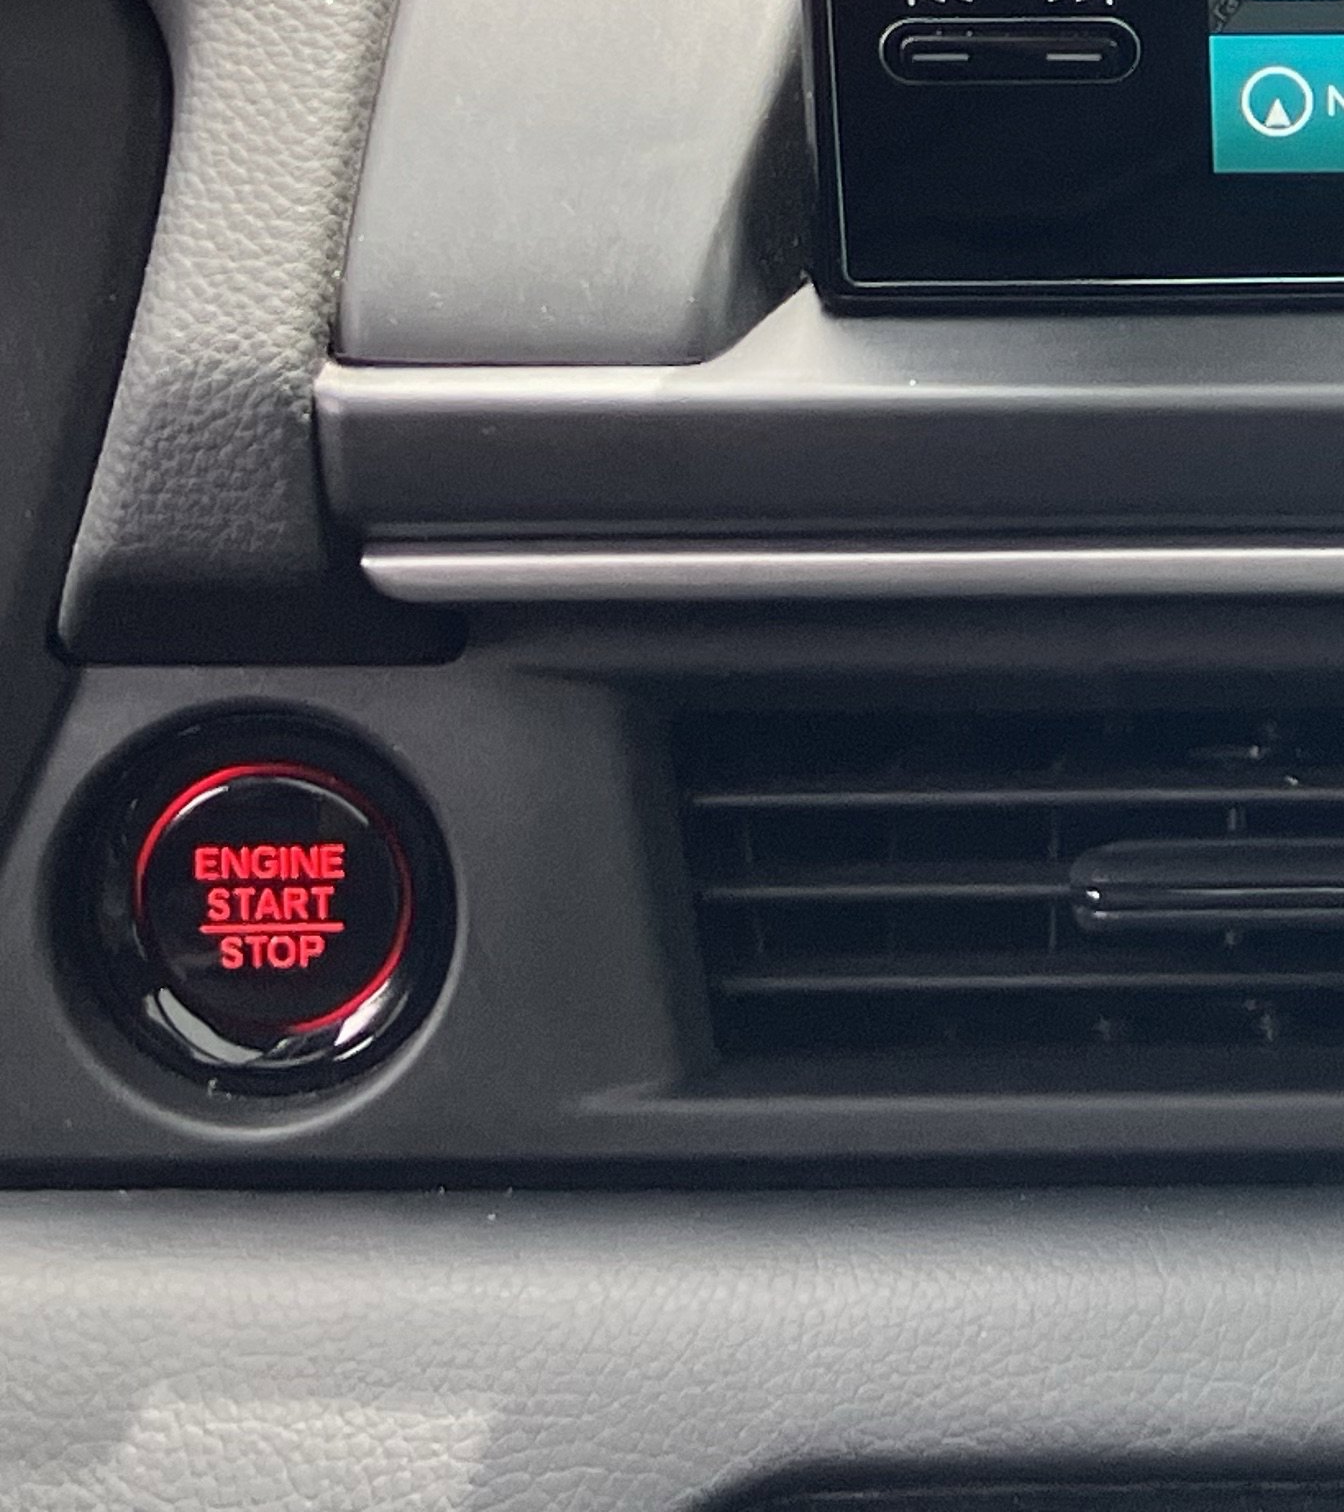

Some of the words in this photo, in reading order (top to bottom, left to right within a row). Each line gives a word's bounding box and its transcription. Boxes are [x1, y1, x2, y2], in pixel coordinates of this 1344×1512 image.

[194, 844, 346, 881] ENGINE
[207, 886, 335, 921] START
[220, 935, 326, 970] STOP
